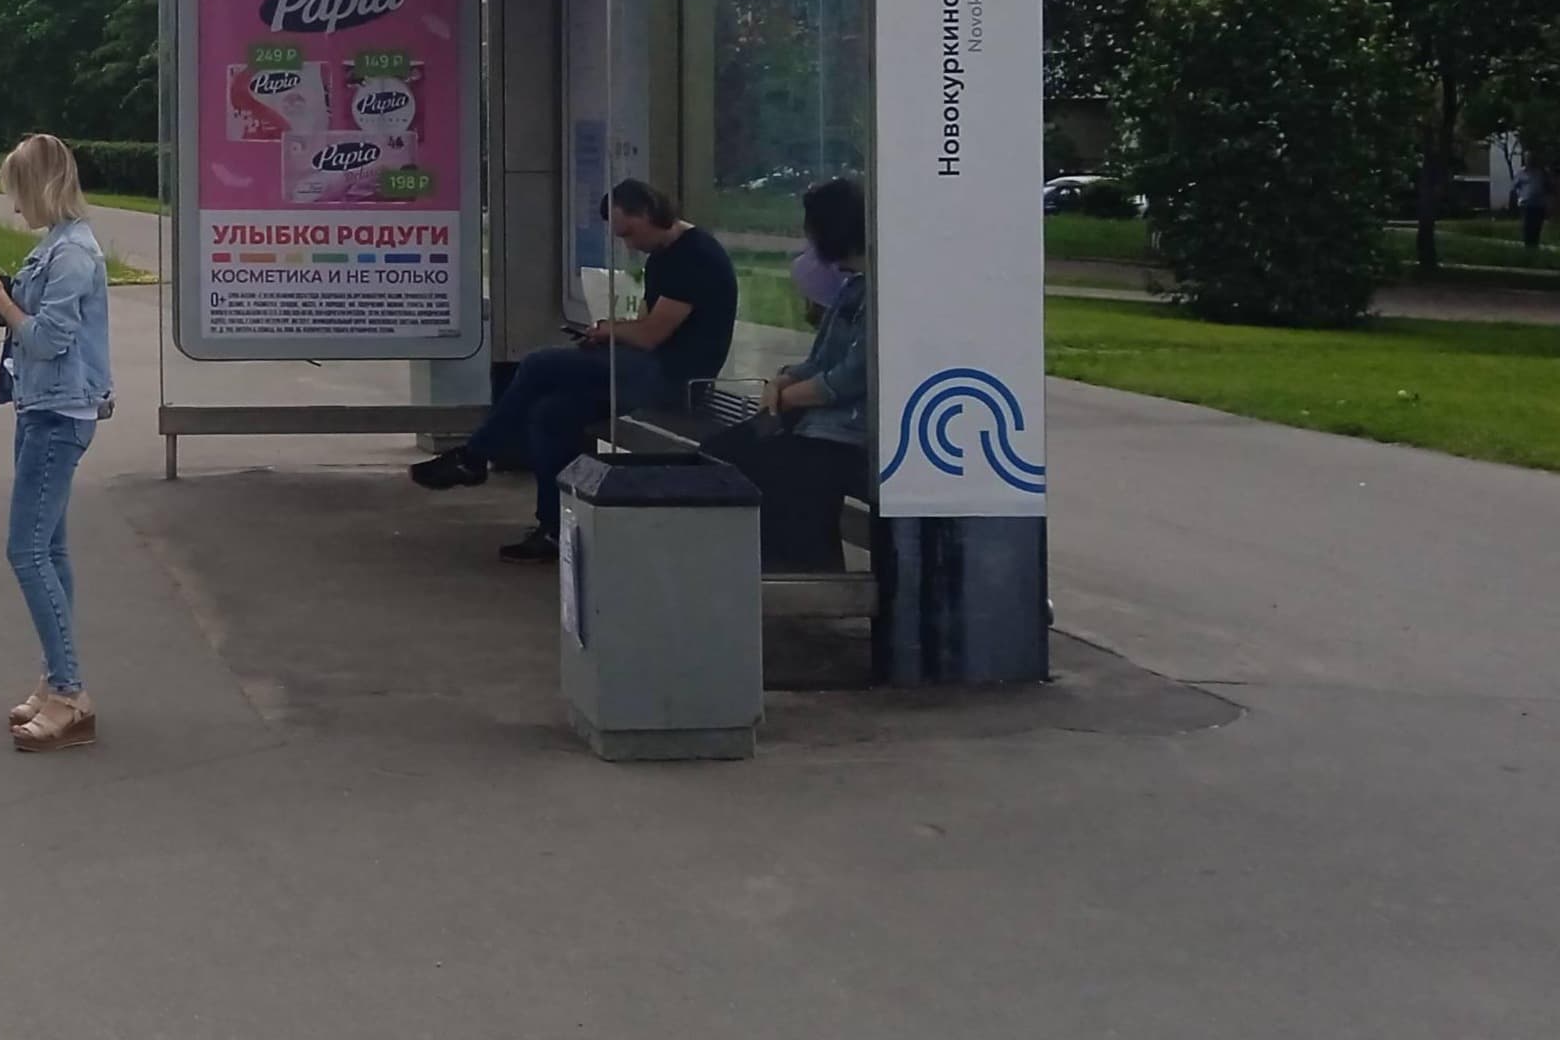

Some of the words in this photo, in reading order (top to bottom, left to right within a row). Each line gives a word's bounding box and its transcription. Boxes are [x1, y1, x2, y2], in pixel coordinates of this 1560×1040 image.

[255, 48, 282, 62] 249
[254, 72, 298, 94] Papia
[360, 92, 407, 114] Papia
[318, 142, 379, 170] Papia
[389, 175, 415, 190] 198
[210, 269, 323, 285] КОСМЕТИКА
[328, 269, 342, 284] И
[346, 269, 370, 284] НЕ
[375, 269, 450, 285] ТОЛЬКО
[210, 291, 227, 308] 0+
